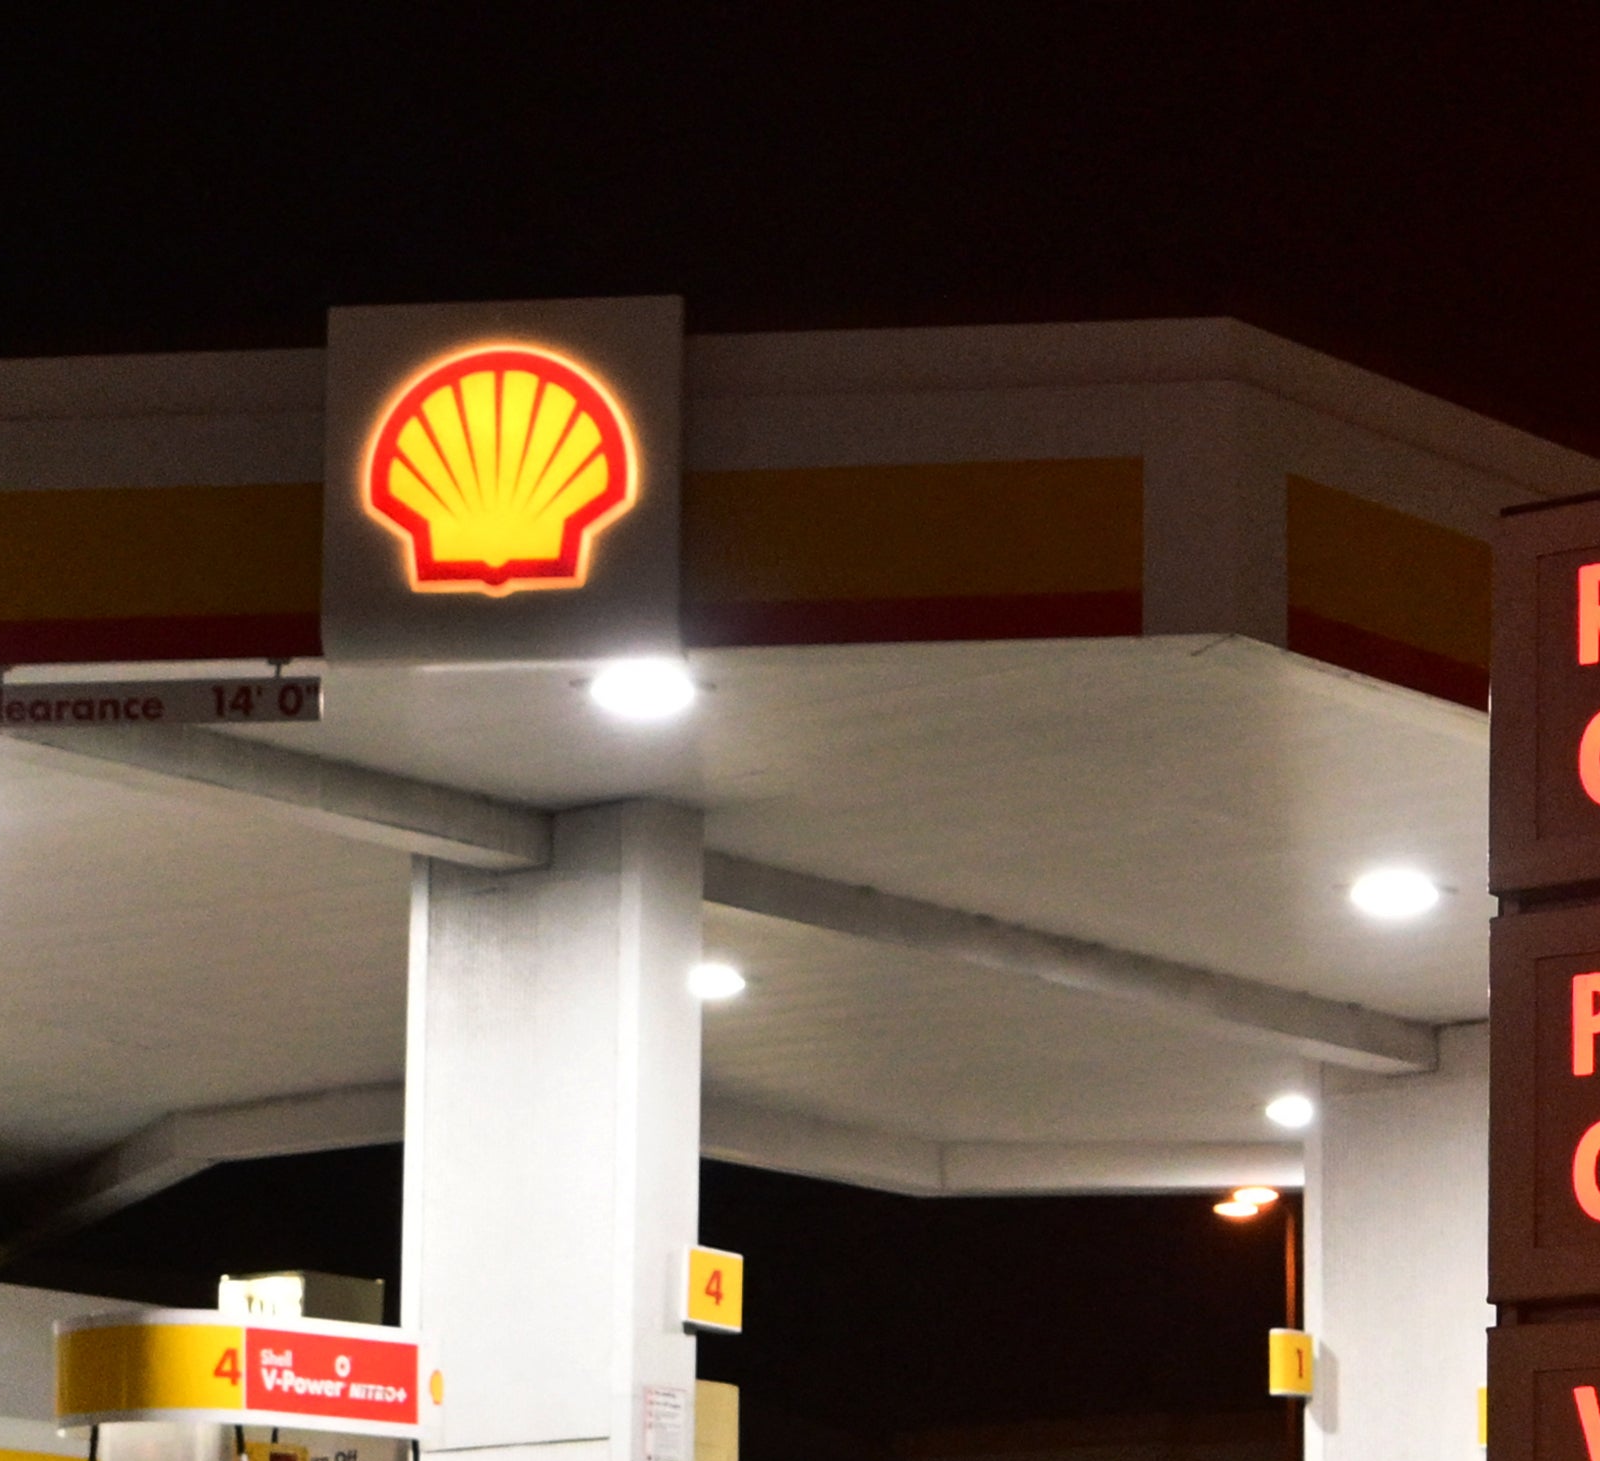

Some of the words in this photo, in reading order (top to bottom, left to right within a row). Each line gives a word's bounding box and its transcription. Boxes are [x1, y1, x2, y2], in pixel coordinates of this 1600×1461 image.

[705, 1269, 723, 1306] 4
[213, 1347, 241, 1386] 4
[260, 1349, 293, 1367] Shell
[1296, 1348, 1304, 1379] 1
[261, 1367, 344, 1398] V-Power
